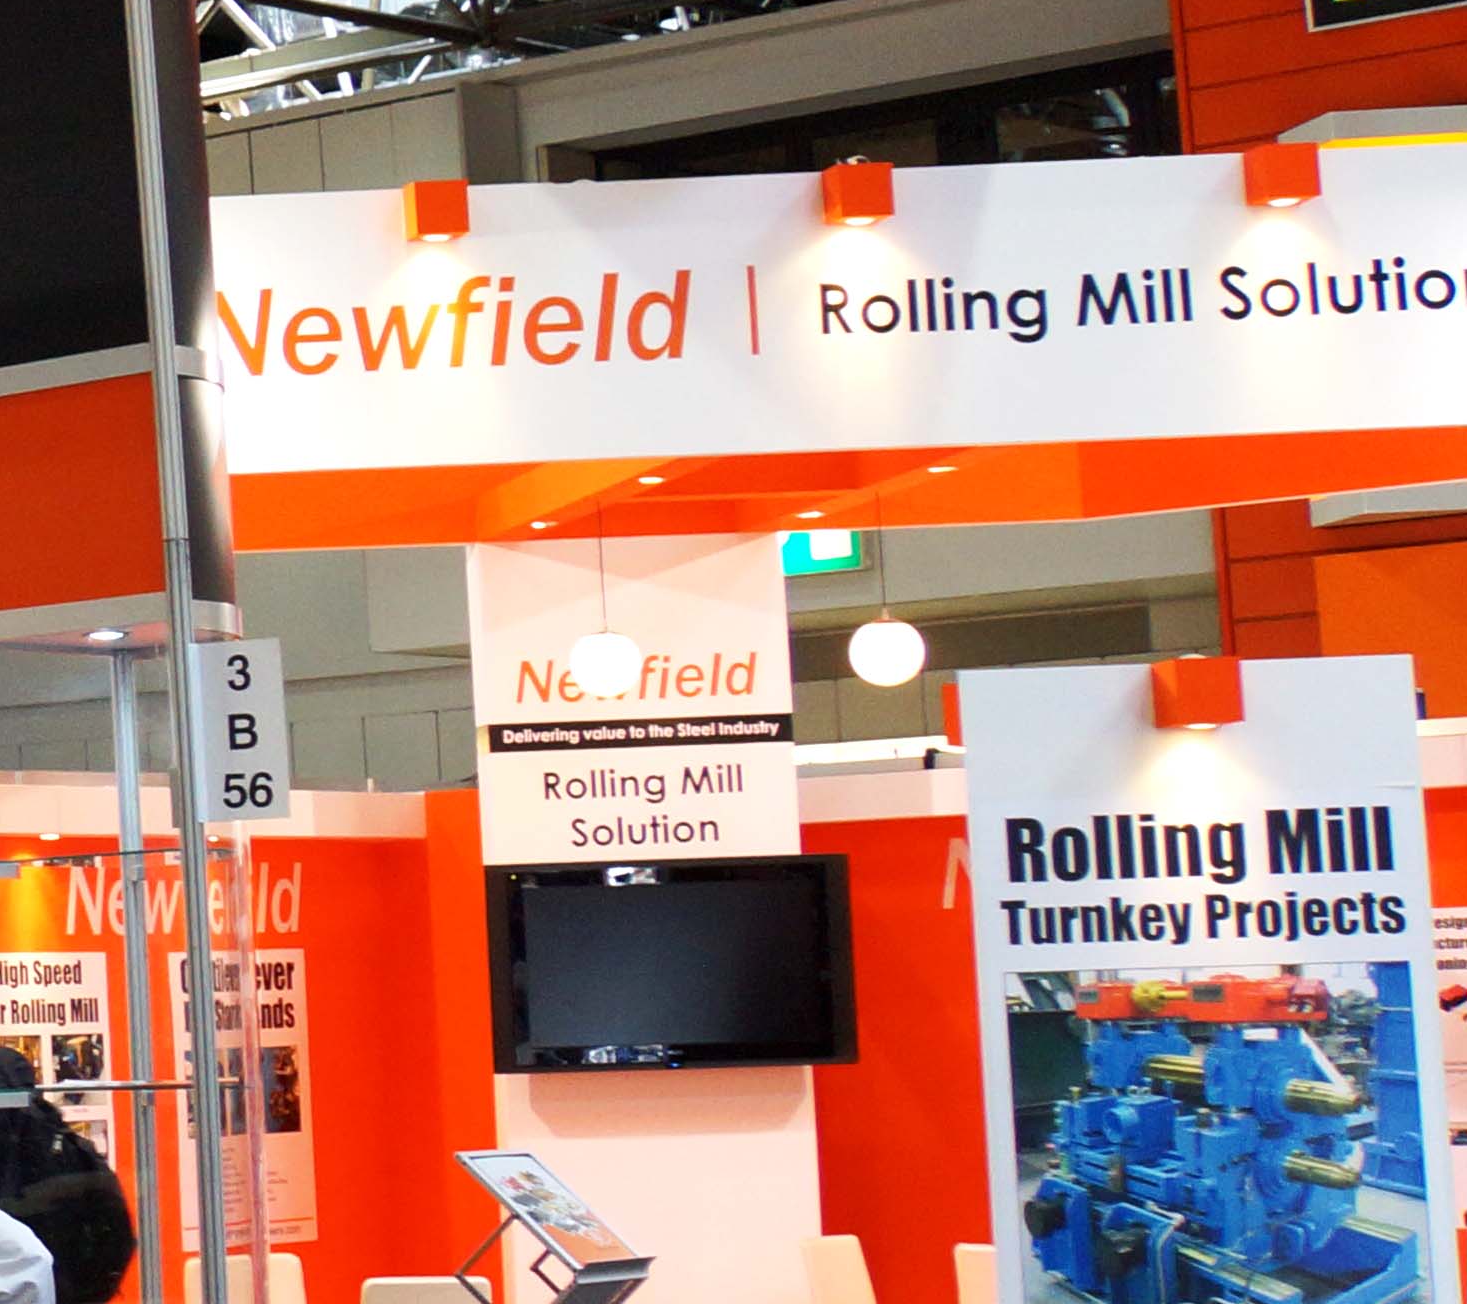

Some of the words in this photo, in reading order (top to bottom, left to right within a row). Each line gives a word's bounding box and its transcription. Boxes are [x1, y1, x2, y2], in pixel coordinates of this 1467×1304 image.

[211, 268, 694, 382] Newfield
[820, 280, 1049, 344] Rolling
[1076, 268, 1193, 328] Mill
[1219, 256, 1467, 320] Solutio
[225, 654, 251, 692] 3
[515, 652, 758, 705] Nefield
[227, 714, 259, 751] B
[502, 728, 581, 745] Delivering
[582, 726, 626, 741] value
[629, 725, 645, 739] to
[648, 723, 675, 739] the
[677, 722, 716, 738] Steel
[718, 720, 780, 736] Industry
[222, 771, 275, 809] 56
[543, 769, 667, 804] Rolling
[680, 763, 744, 795] Mill
[570, 815, 720, 848] Solution
[1004, 813, 1249, 885] Rolling
[1264, 805, 1397, 874] Mill
[1000, 895, 1192, 946] Turnkey
[1205, 891, 1408, 942] Projects
[33, 959, 83, 987] Speed
[10, 999, 66, 1027] Rolling
[70, 997, 99, 1023] Mill
